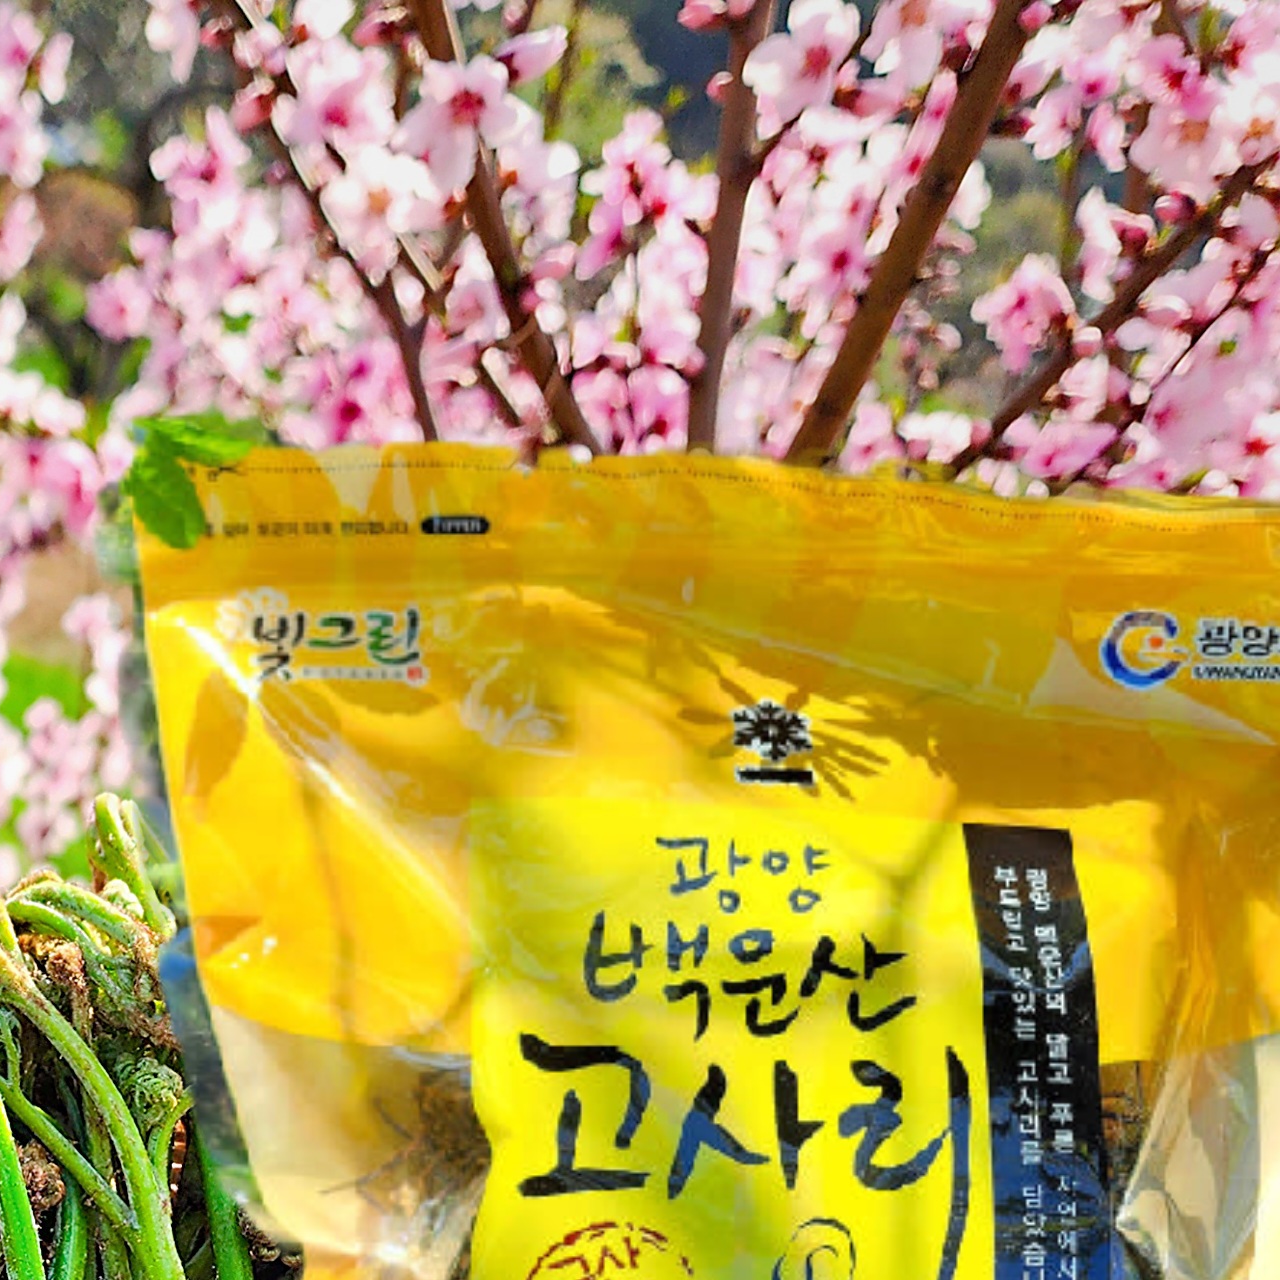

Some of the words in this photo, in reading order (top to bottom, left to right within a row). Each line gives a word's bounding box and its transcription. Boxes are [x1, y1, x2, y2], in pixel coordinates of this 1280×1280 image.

[253, 607, 420, 681] 빛그린
[656, 837, 831, 914] 광양
[583, 910, 918, 1041] 백운산
[1008, 966, 1037, 1041] 맛있는
[1016, 1061, 1044, 1166] 고사리를
